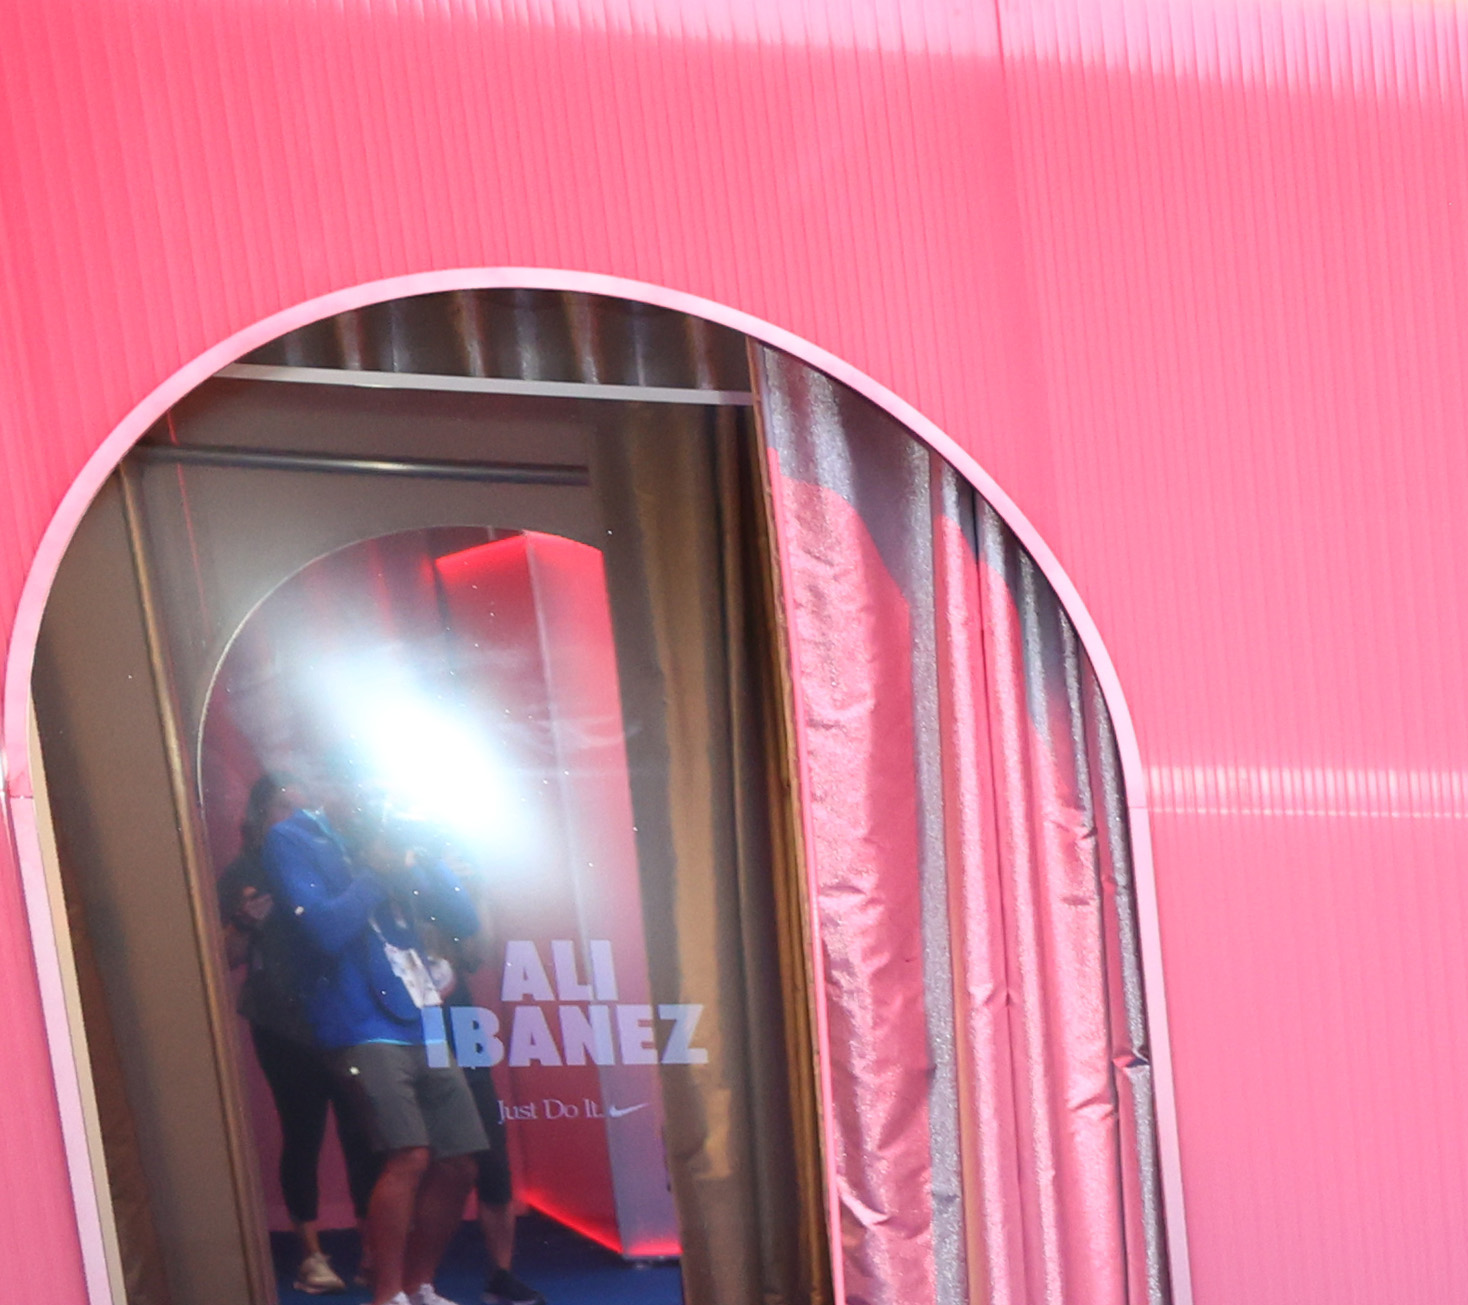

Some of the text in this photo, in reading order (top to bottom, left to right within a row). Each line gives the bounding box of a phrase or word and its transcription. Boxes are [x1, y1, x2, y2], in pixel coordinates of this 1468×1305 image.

[501, 939, 618, 1001] ALI
[421, 1003, 709, 1068] IBANEZ
[497, 1100, 538, 1125] Just
[543, 1098, 578, 1119] Do
